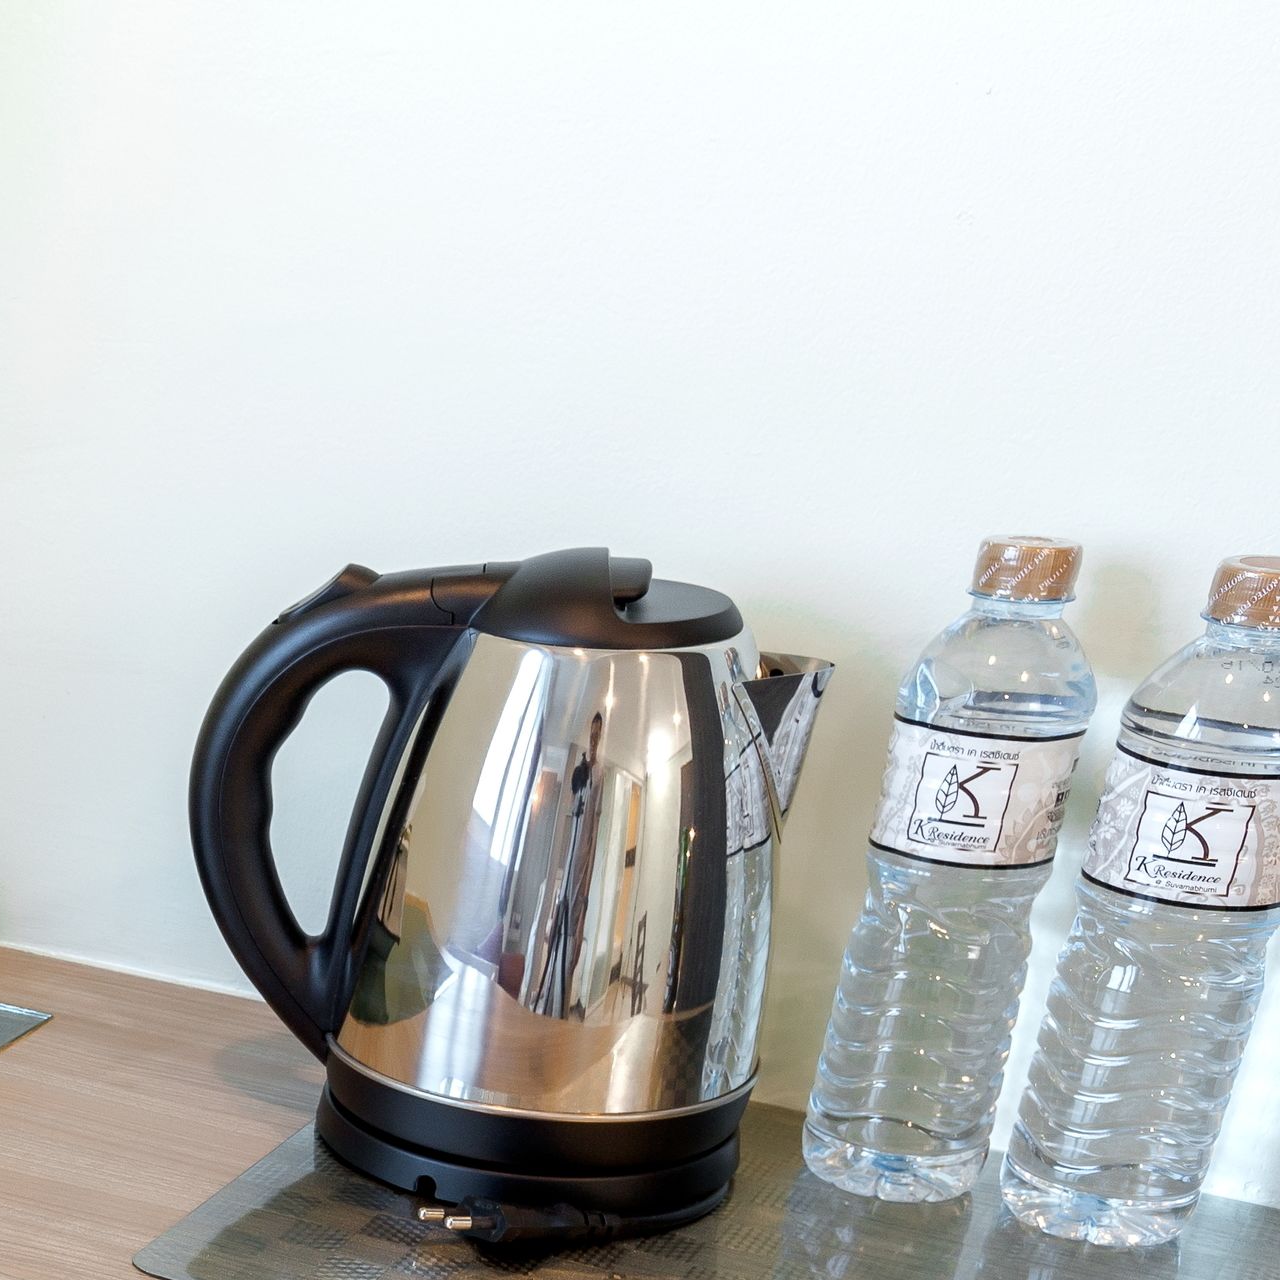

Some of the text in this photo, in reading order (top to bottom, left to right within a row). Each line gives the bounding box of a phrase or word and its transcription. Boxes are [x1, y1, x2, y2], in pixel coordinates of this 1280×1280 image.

[913, 818, 991, 844] K Residence
[1135, 855, 1222, 884] K Residence
